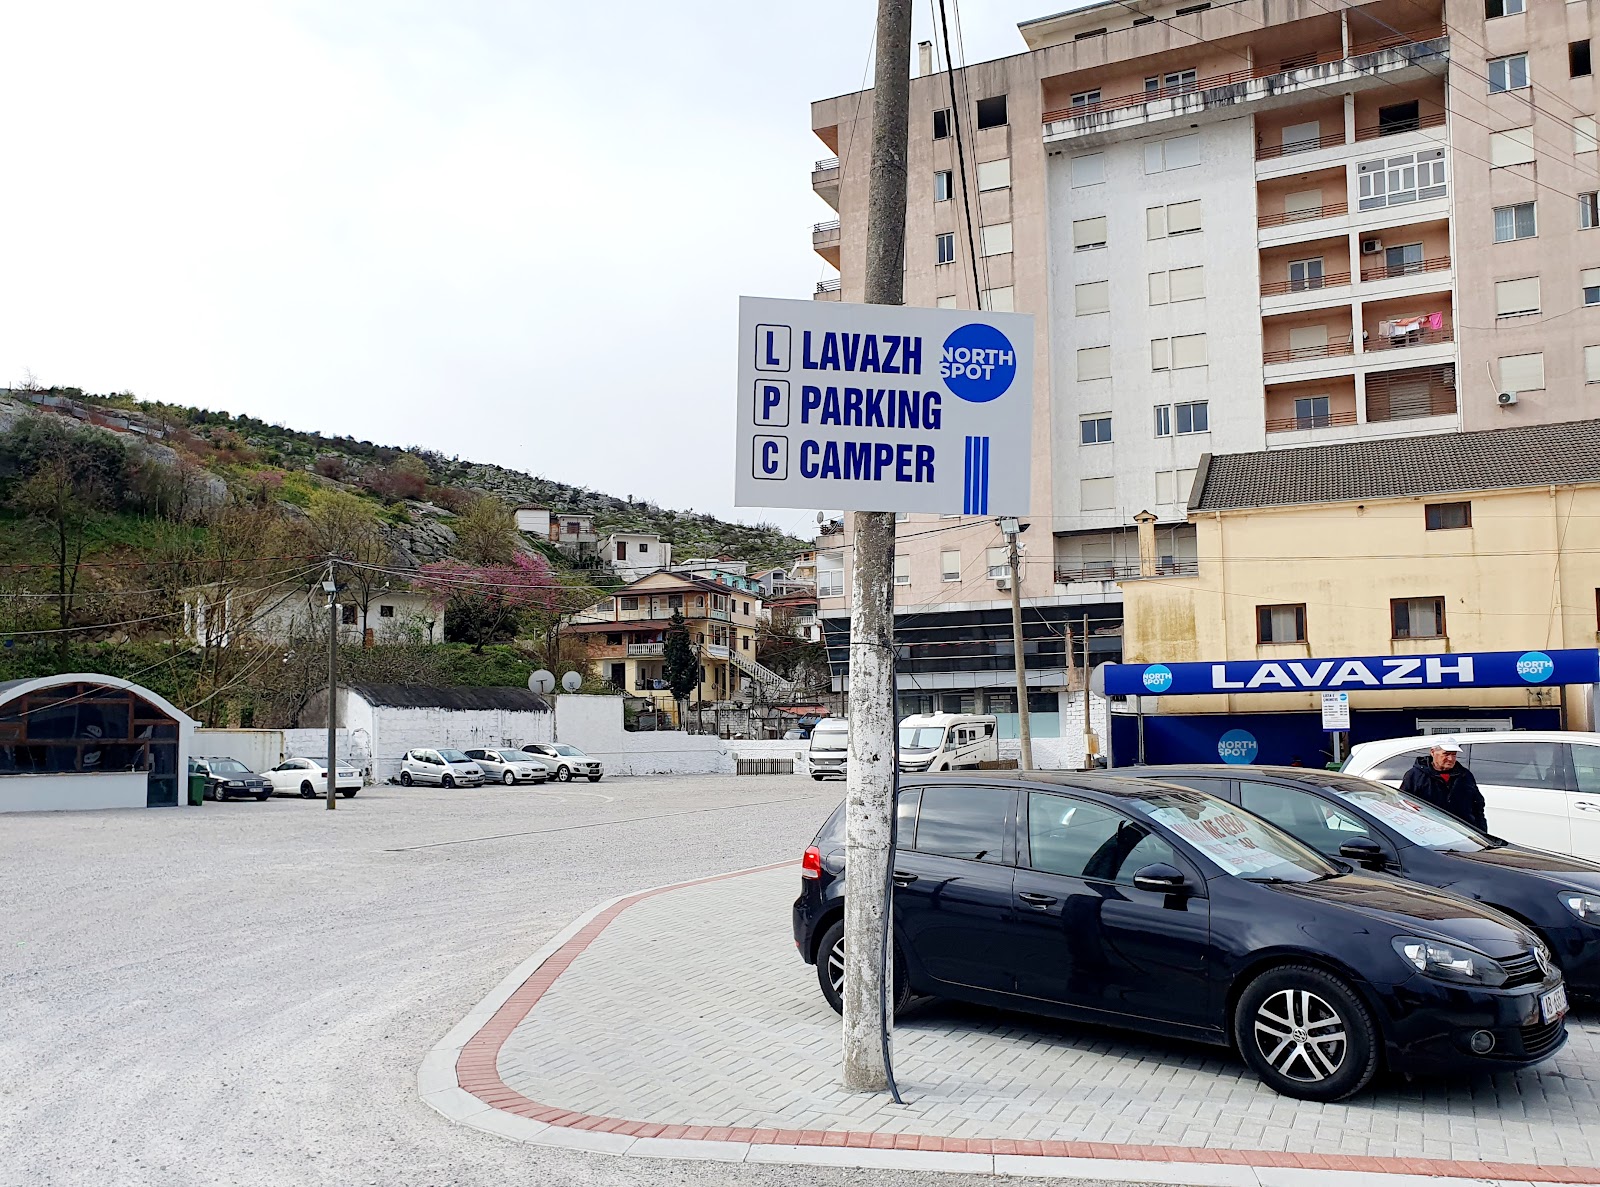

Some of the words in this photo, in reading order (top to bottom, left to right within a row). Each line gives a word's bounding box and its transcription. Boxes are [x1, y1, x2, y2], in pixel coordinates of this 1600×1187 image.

[766, 330, 780, 366] L
[802, 330, 922, 375] LAVAZH
[940, 347, 1013, 365] NORTH
[939, 362, 995, 380] SPOT
[762, 385, 781, 420] P
[801, 385, 942, 430] PARKING
[762, 440, 779, 475] C
[799, 439, 935, 483] CAMPER
[1211, 656, 1474, 689] LAVAZH
[1516, 660, 1553, 668] NORTH
[1217, 740, 1257, 749] NORTH
[1217, 748, 1247, 757] SPOT
